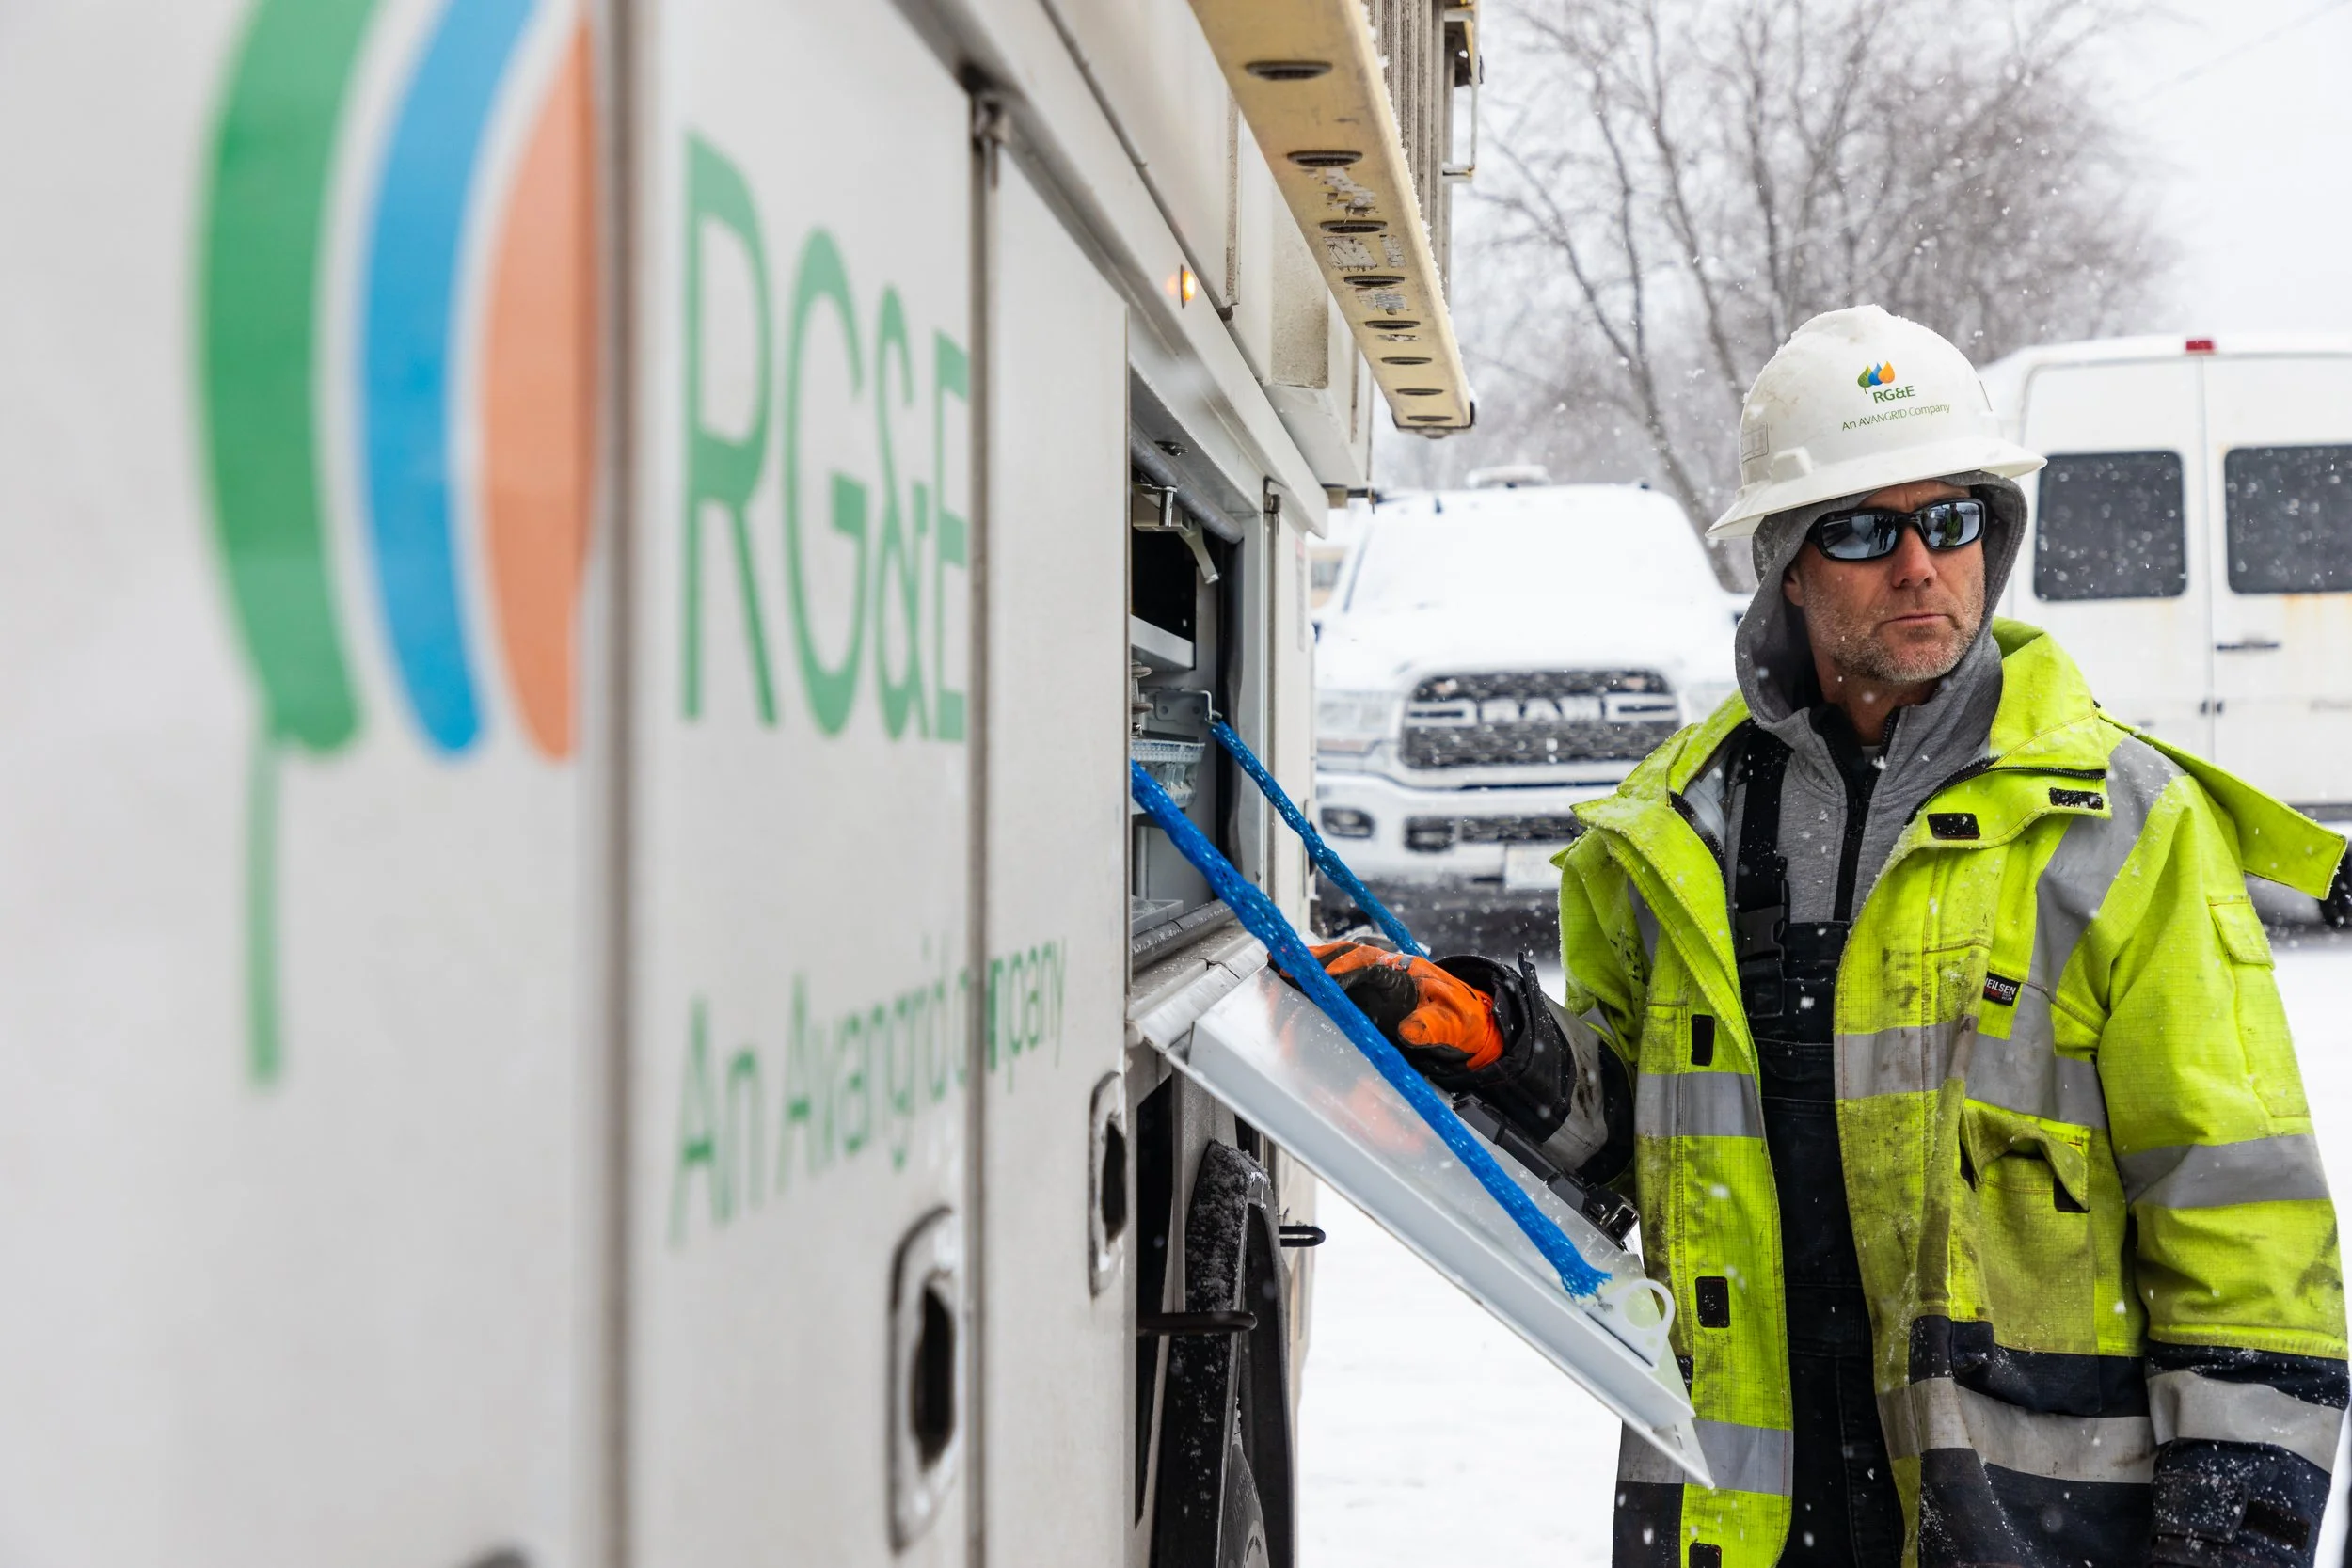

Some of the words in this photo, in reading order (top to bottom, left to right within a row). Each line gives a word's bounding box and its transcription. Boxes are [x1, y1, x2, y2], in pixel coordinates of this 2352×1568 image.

[1872, 385, 1916, 404] RG&E
[1842, 420, 1857, 431] An
[1858, 409, 1908, 426] AVANGRID
[1909, 404, 1950, 418] Company
[681, 130, 969, 743] RG&E
[1482, 697, 1600, 722] RAM
[668, 992, 764, 1246] An
[776, 931, 948, 1193] Avangrid
